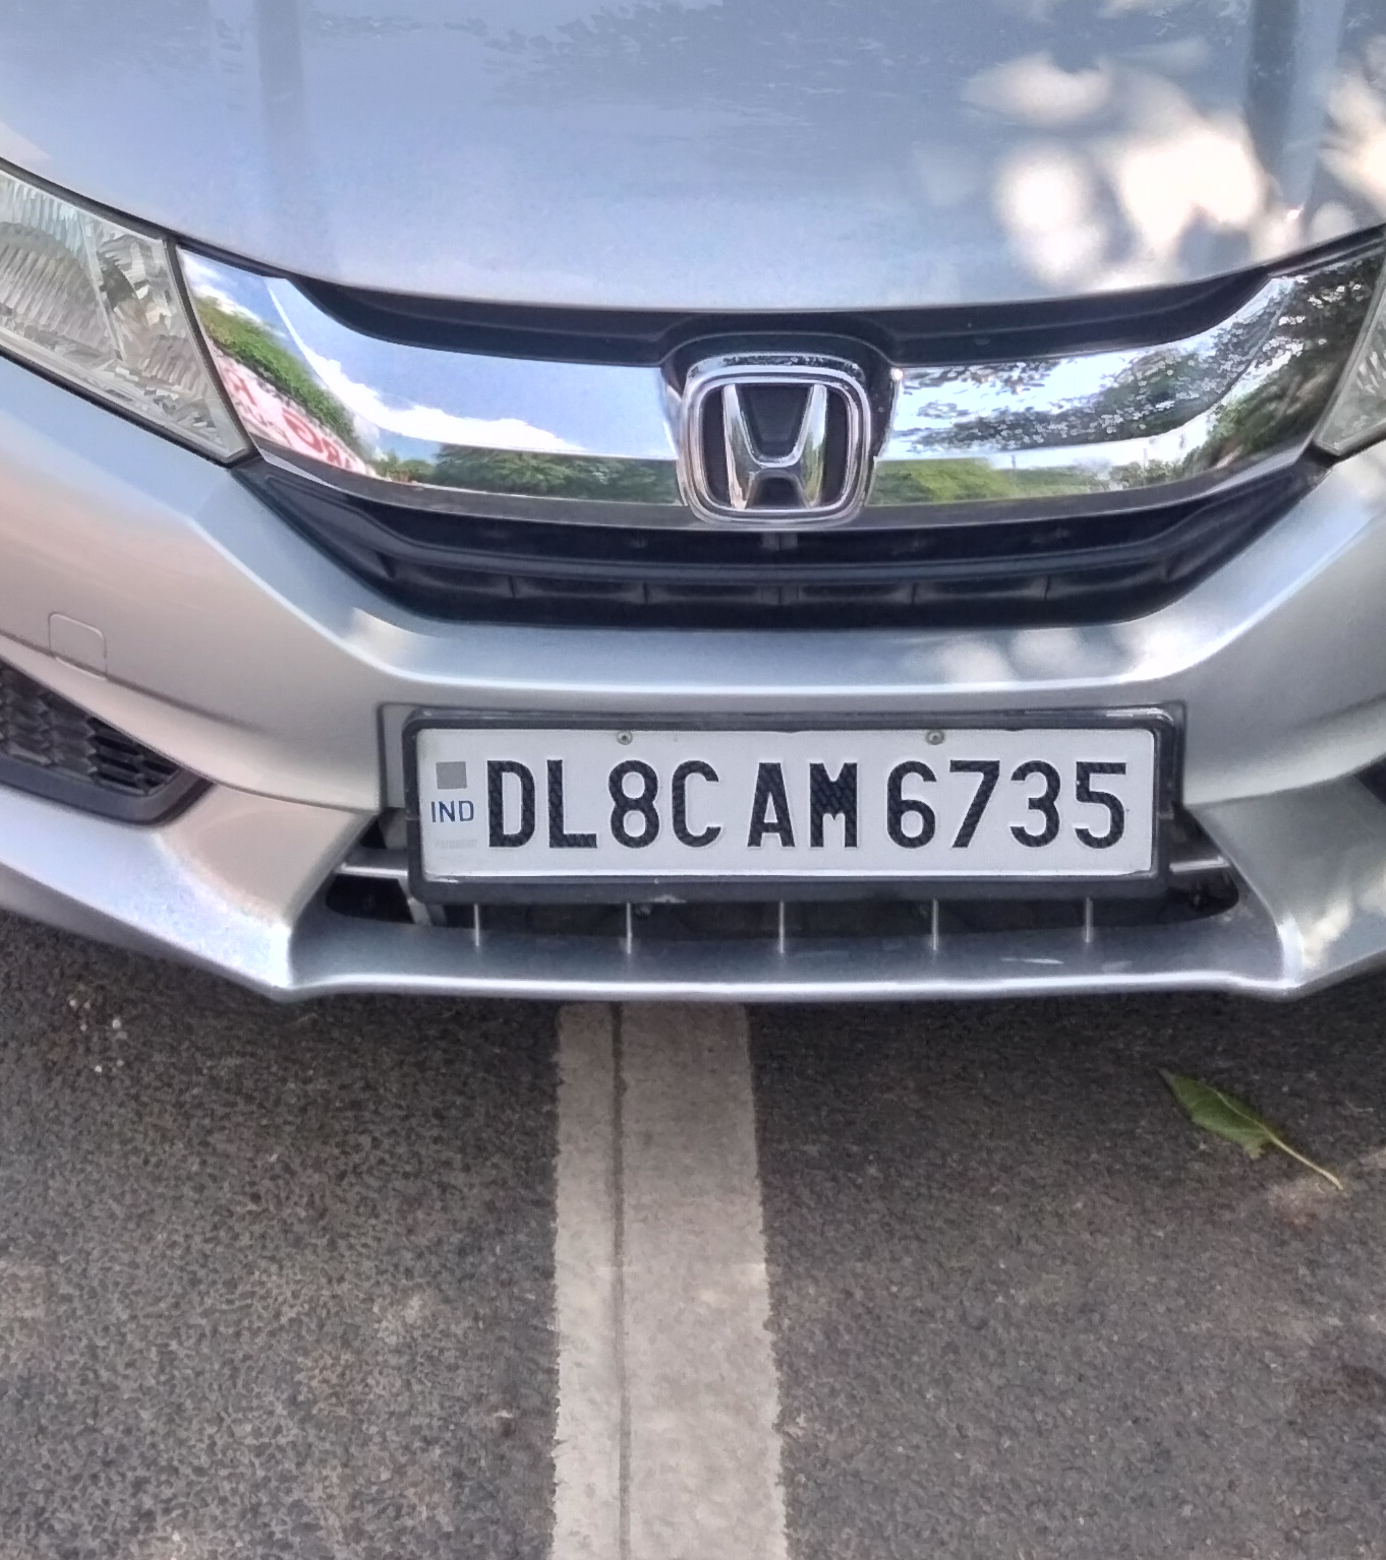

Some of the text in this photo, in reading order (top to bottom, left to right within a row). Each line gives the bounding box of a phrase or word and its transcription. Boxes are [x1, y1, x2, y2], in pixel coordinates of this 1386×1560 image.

[430, 800, 475, 823] IND
[747, 761, 859, 849] AM
[887, 759, 1127, 849] 6735
